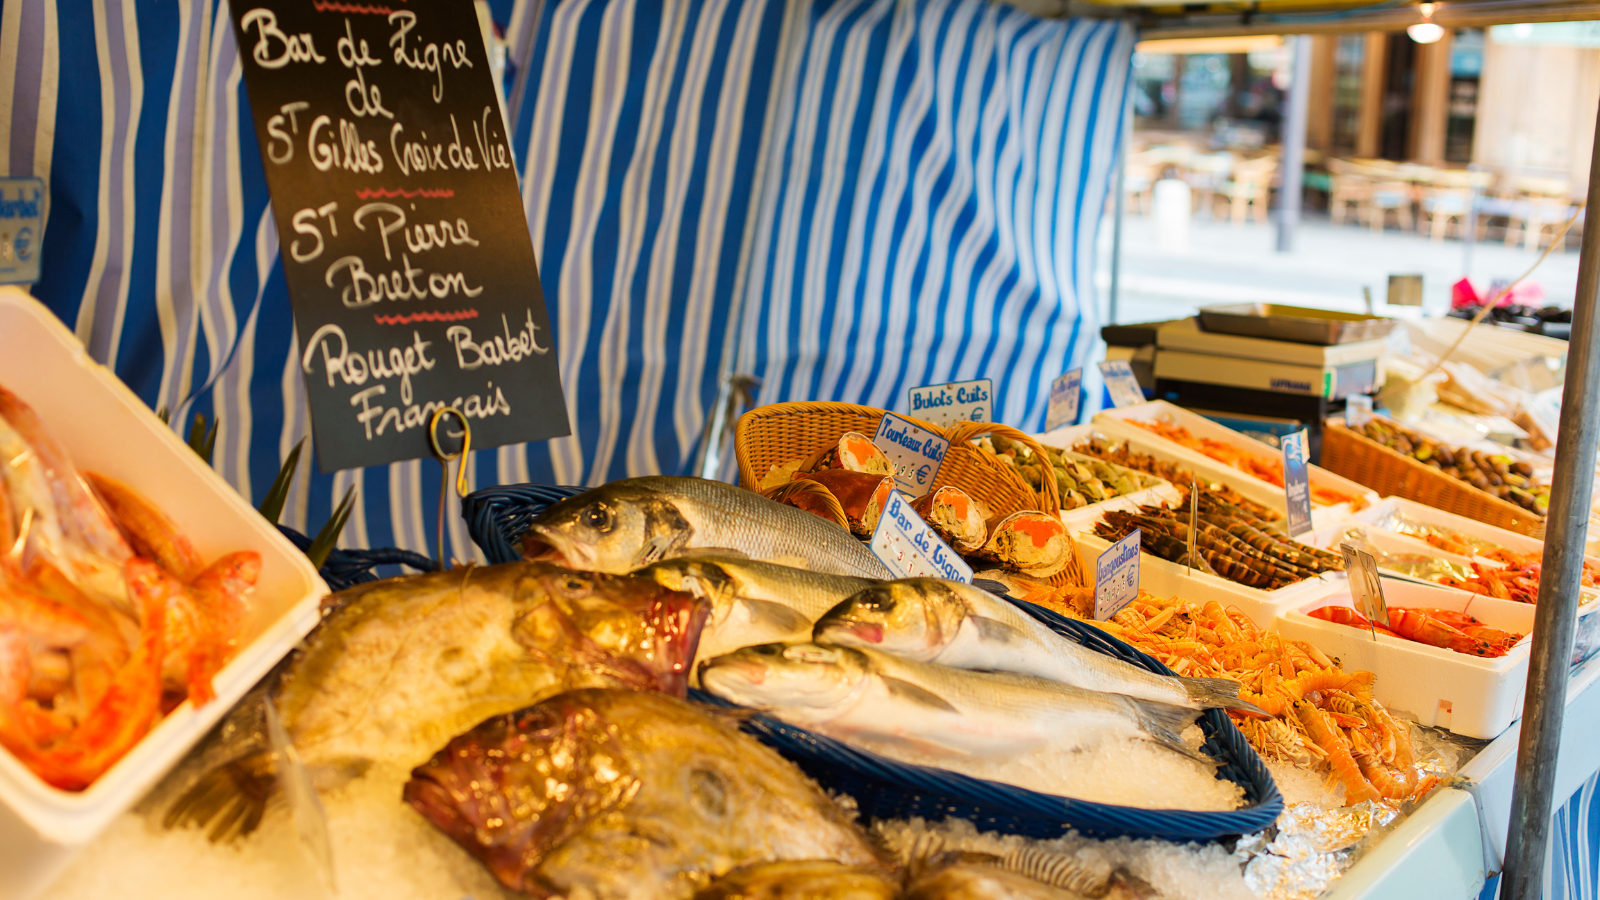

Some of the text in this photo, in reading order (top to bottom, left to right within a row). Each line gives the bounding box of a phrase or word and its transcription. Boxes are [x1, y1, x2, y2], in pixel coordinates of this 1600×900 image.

[241, 8, 473, 103] Bar de Ligne
[345, 66, 394, 118] de
[308, 114, 383, 174] Gilles
[448, 113, 478, 170] de
[473, 106, 510, 172] Vie
[353, 202, 480, 261] Pierre
[325, 252, 484, 309] Breton
[302, 307, 549, 406] Rouget Barbet
[913, 385, 988, 411] Bulots Cuits
[880, 418, 944, 463] Tourteaux Cuits
[888, 497, 913, 531] Bar
[914, 527, 930, 553] de
[1098, 543, 1139, 582] Langoustines
